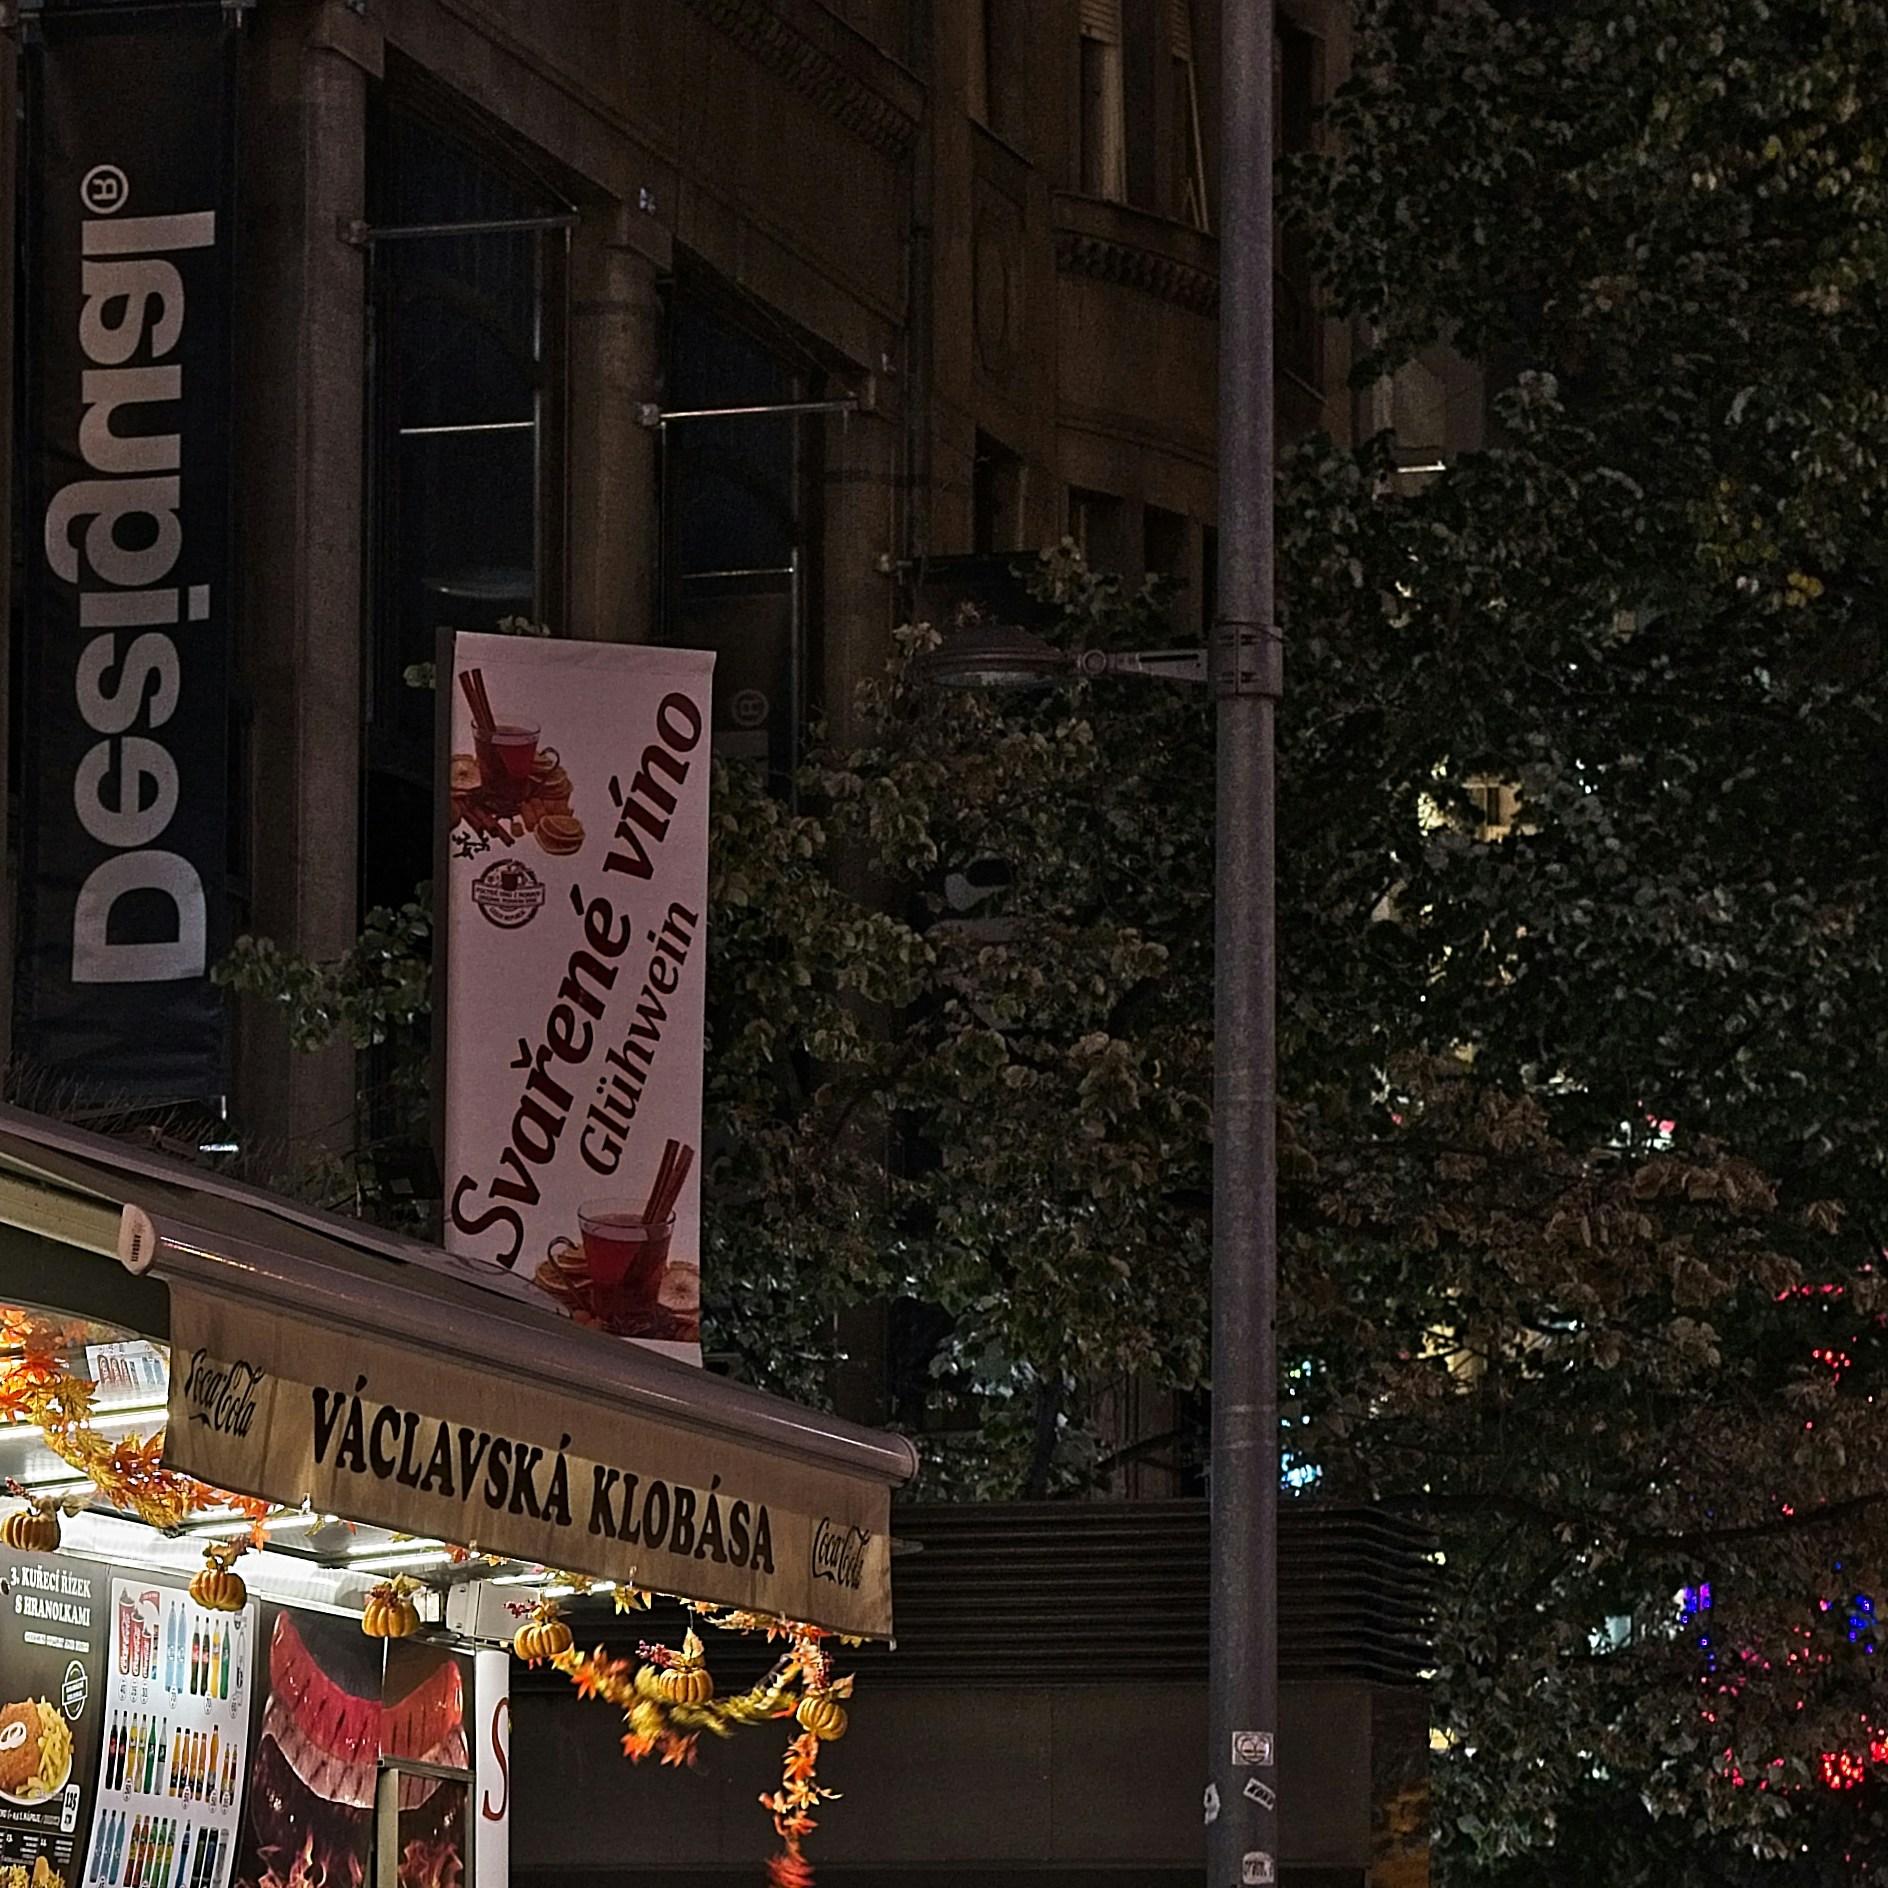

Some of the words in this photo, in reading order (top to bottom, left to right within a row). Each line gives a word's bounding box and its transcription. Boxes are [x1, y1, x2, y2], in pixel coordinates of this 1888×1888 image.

[452, 884, 633, 1266] Svařené
[602, 690, 703, 884] víno
[578, 901, 698, 1176] Glühwein
[185, 1348, 264, 1438] Coca-Cola
[311, 1373, 573, 1528] VÁCLAVSKÁ
[588, 1475, 775, 1575] KLOBÁSA
[21, 1564, 59, 1594] KUŘECÍ
[60, 1571, 91, 1598] ŘÍZEK
[811, 1516, 870, 1590] Coca-Cola
[24, 1595, 91, 1627] HRANOLKAMI
